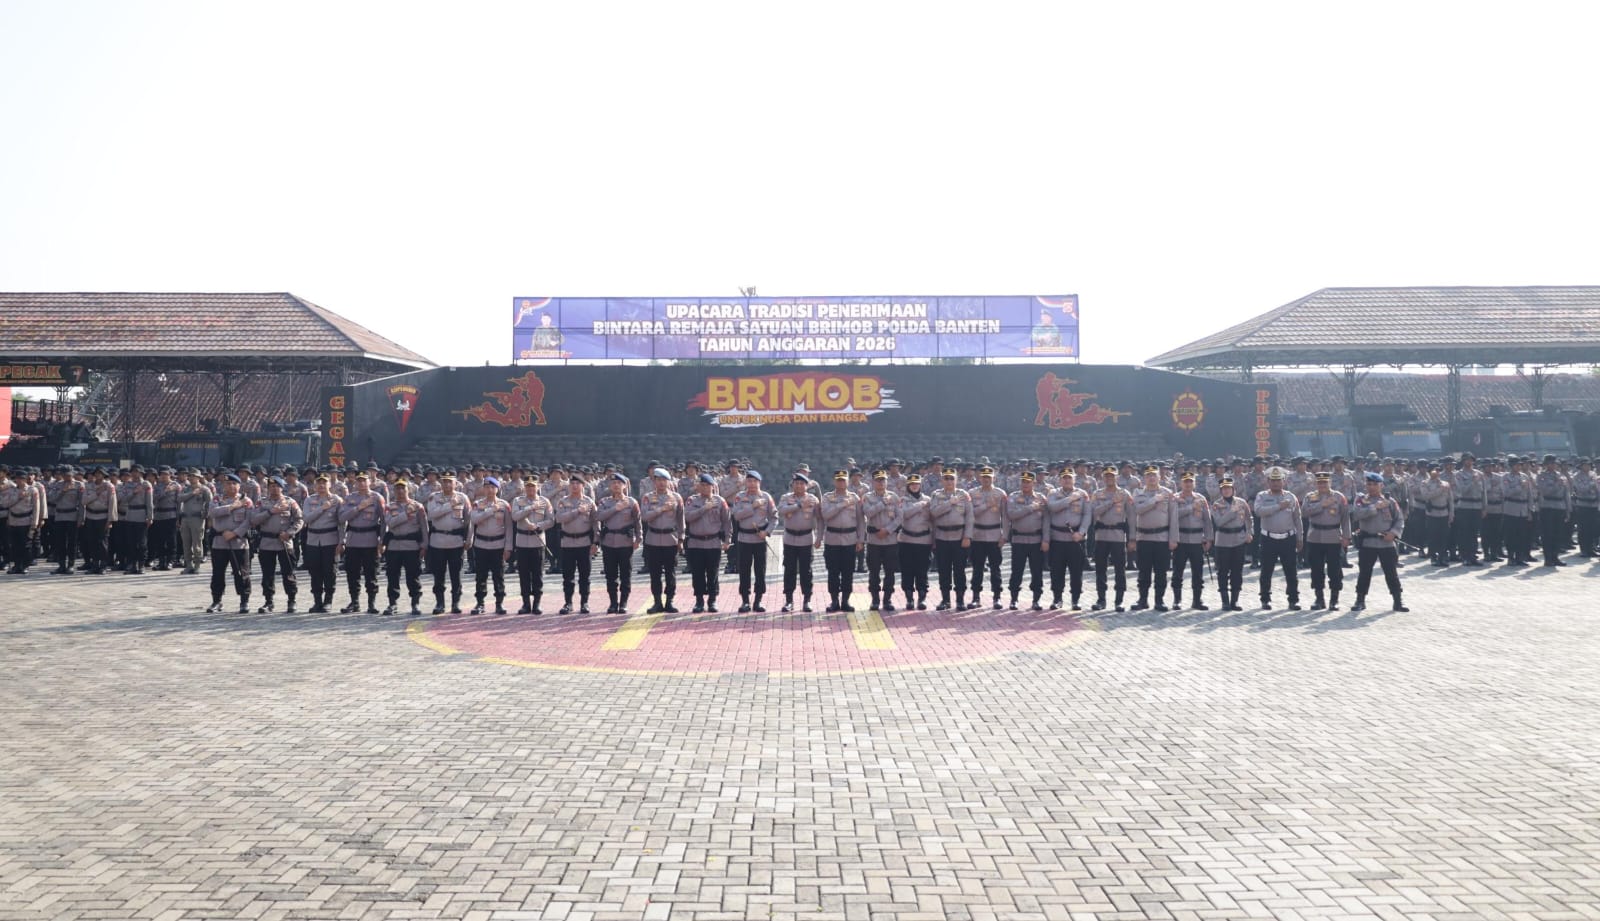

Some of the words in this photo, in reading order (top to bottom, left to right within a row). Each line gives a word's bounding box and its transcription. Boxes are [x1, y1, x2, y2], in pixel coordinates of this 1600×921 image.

[666, 304, 744, 318] UPACARA
[748, 304, 813, 318] TRADISI
[817, 303, 928, 318] PENERIMAAN
[593, 321, 666, 335] BINTARA
[670, 321, 736, 335] REMAJA
[739, 320, 804, 335] SATUAN
[808, 320, 873, 334] BRIMOB
[877, 320, 930, 334] POLDA
[935, 319, 1000, 334] BANTEN
[698, 337, 752, 352] TAHUN
[758, 337, 851, 351] ANGGARAN
[855, 336, 896, 351] 2026
[708, 377, 882, 410] BRIMOB
[719, 414, 760, 425] UNTUK
[761, 414, 791, 424] NUSA
[793, 413, 818, 424] DAN
[820, 413, 868, 423] BANGSA
